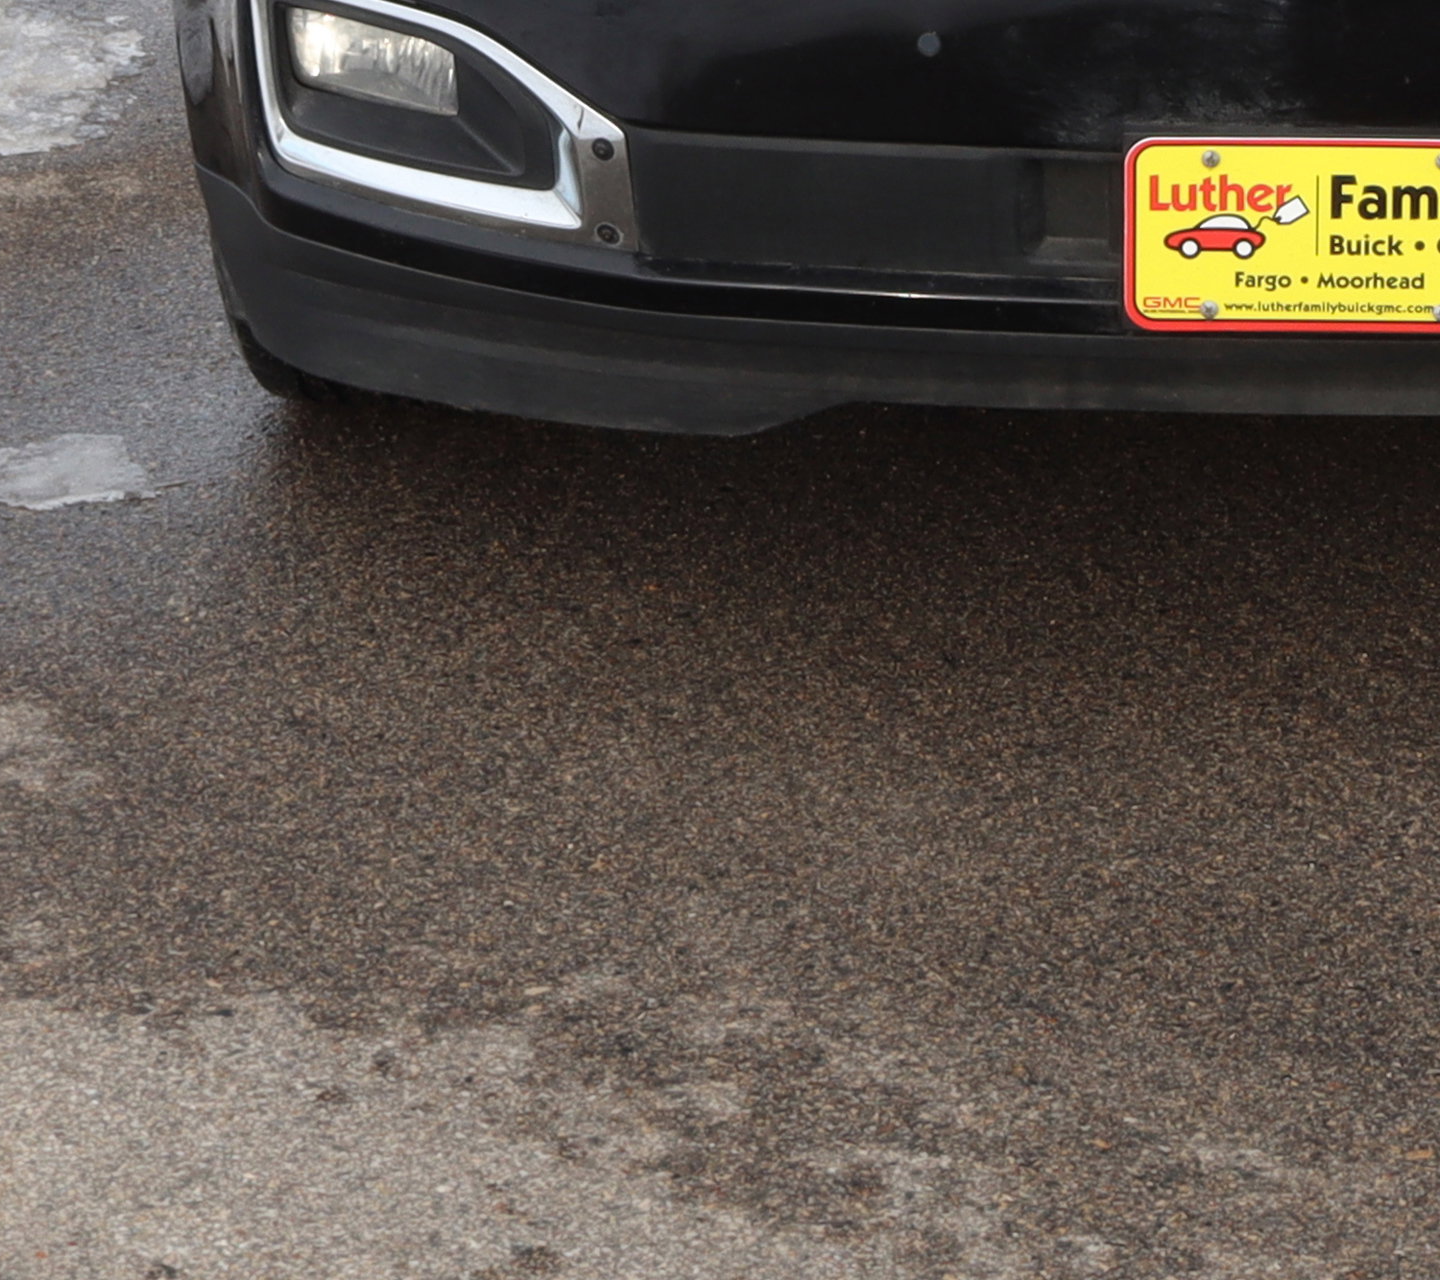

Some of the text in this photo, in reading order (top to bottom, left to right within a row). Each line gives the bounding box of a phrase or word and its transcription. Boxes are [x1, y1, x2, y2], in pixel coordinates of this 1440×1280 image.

[1148, 174, 1293, 213] Luther
[1329, 234, 1403, 257] Buick
[1234, 271, 1425, 291] Fargo Moorhead
[1143, 297, 1202, 309] GMC
[1224, 301, 1435, 316] www.lutherfamilybuickgmc.com
